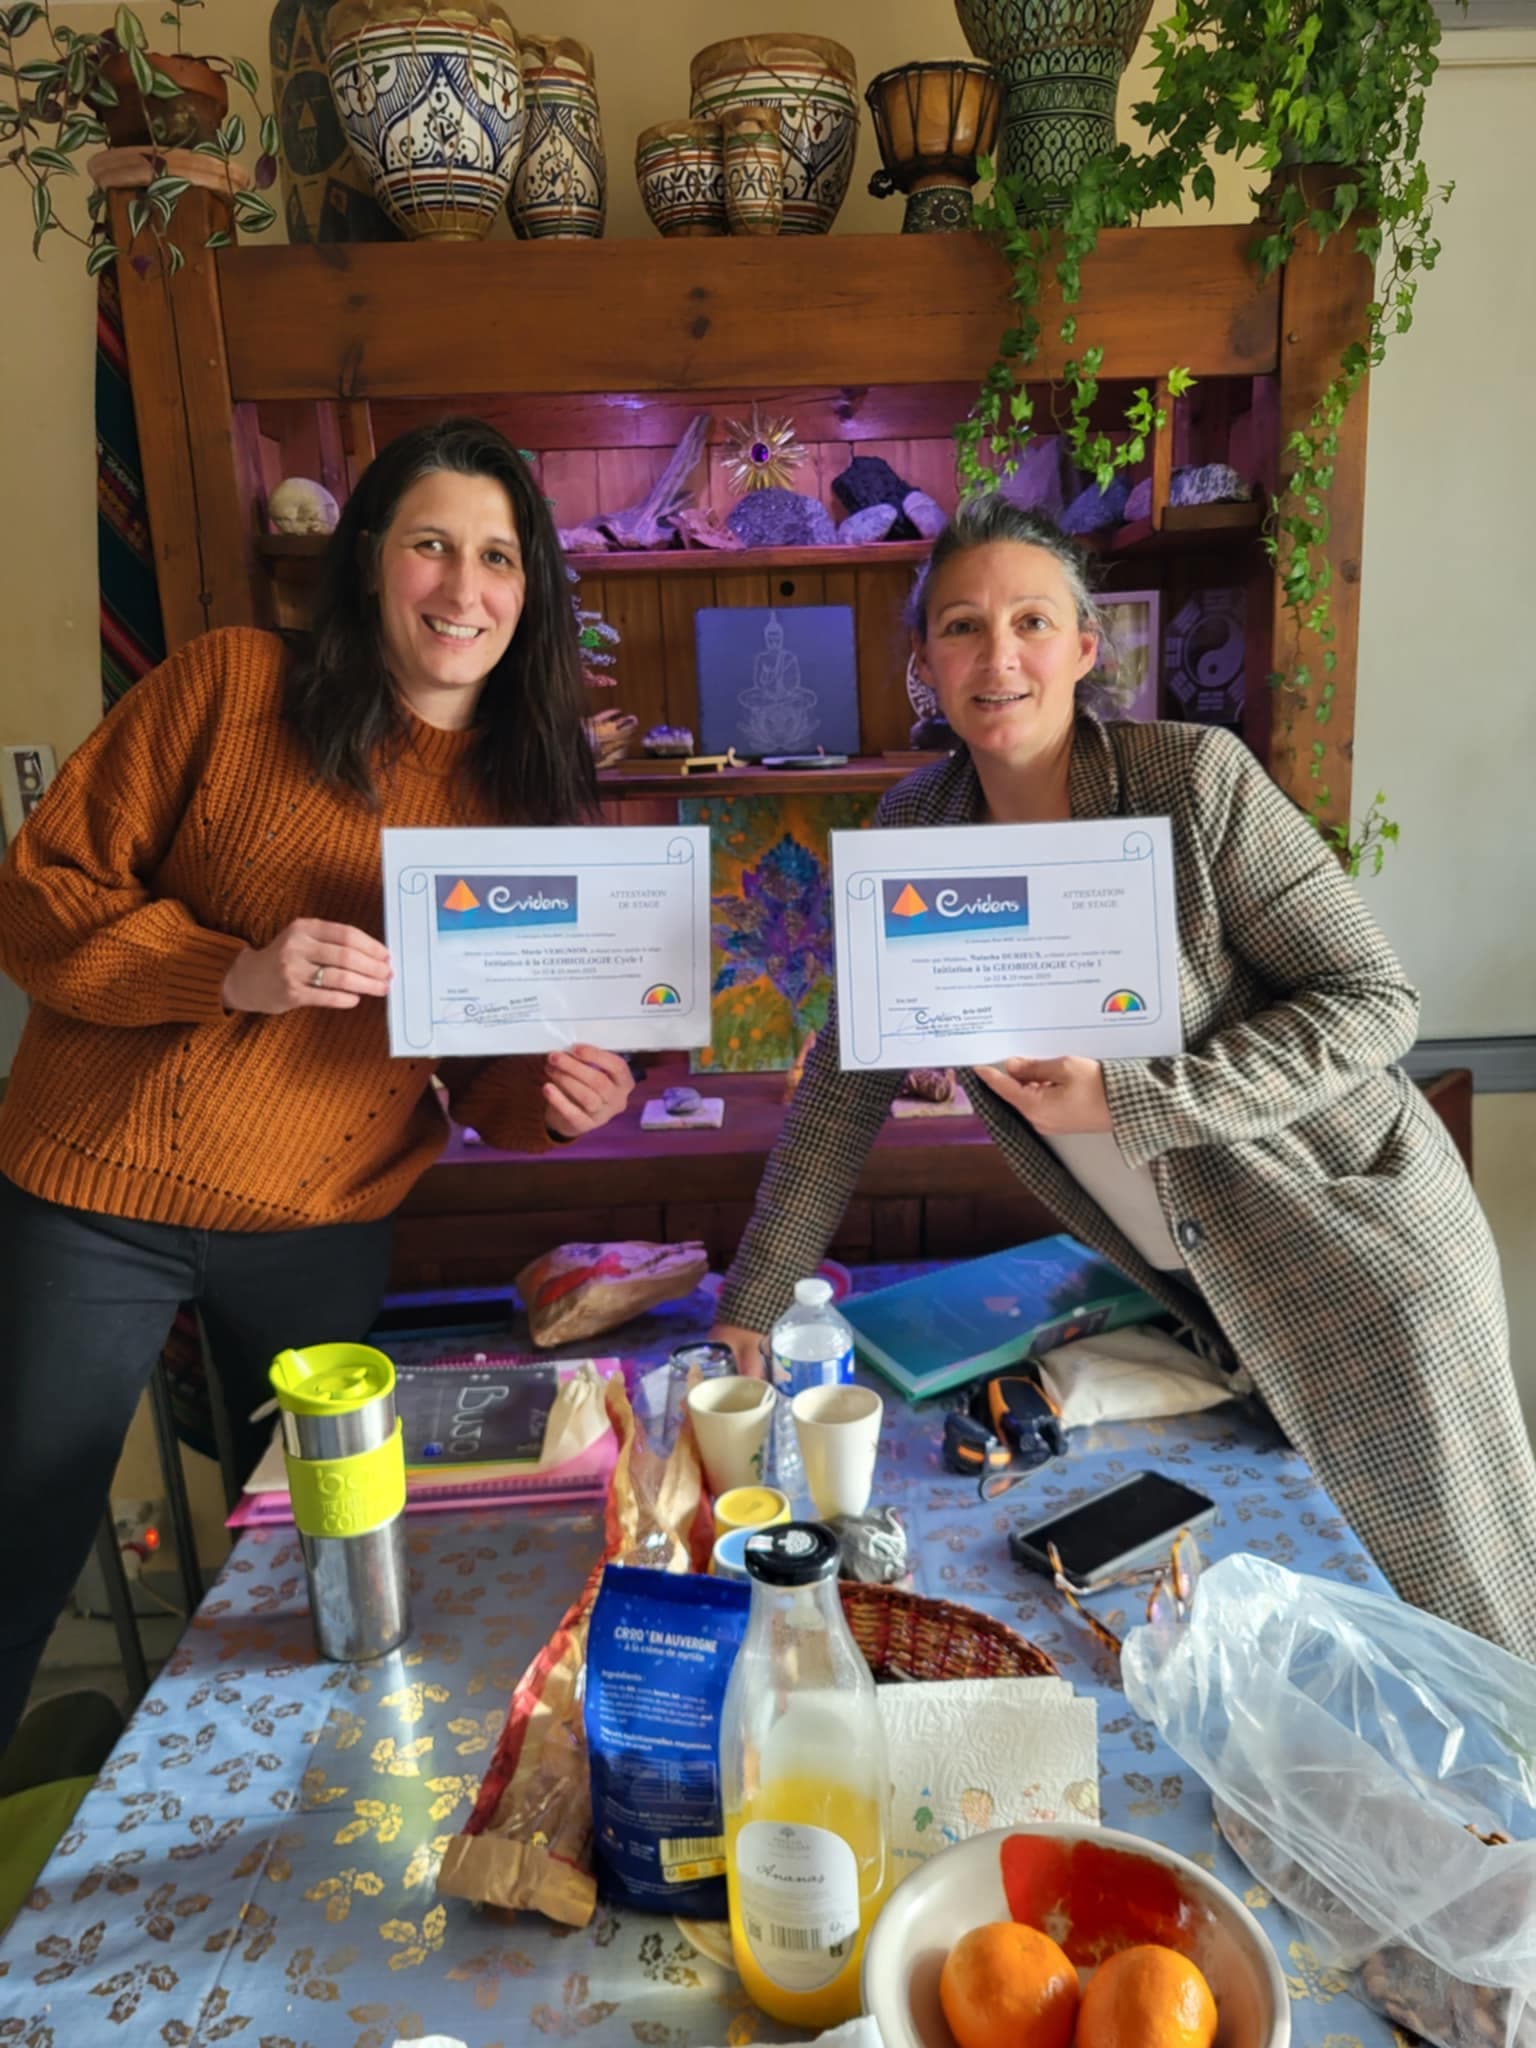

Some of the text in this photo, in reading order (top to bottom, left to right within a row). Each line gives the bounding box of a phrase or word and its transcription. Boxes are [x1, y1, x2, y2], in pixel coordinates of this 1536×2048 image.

[610, 889, 667, 899] ATTESTATION
[1062, 887, 1125, 899] ATTESTATION
[618, 899, 660, 909] DE STAGE
[1072, 899, 1118, 910] DE STAGE
[484, 958, 523, 968] Initiation
[532, 957, 541, 967] la
[614, 955, 638, 966] Cycle
[932, 964, 973, 974] Initiation
[982, 963, 991, 972] la
[1070, 959, 1095, 970] Cycle
[664, 1632, 718, 1653] AUVERGNE
[665, 1648, 676, 1658] de
[756, 1864, 825, 1884] Ananas
